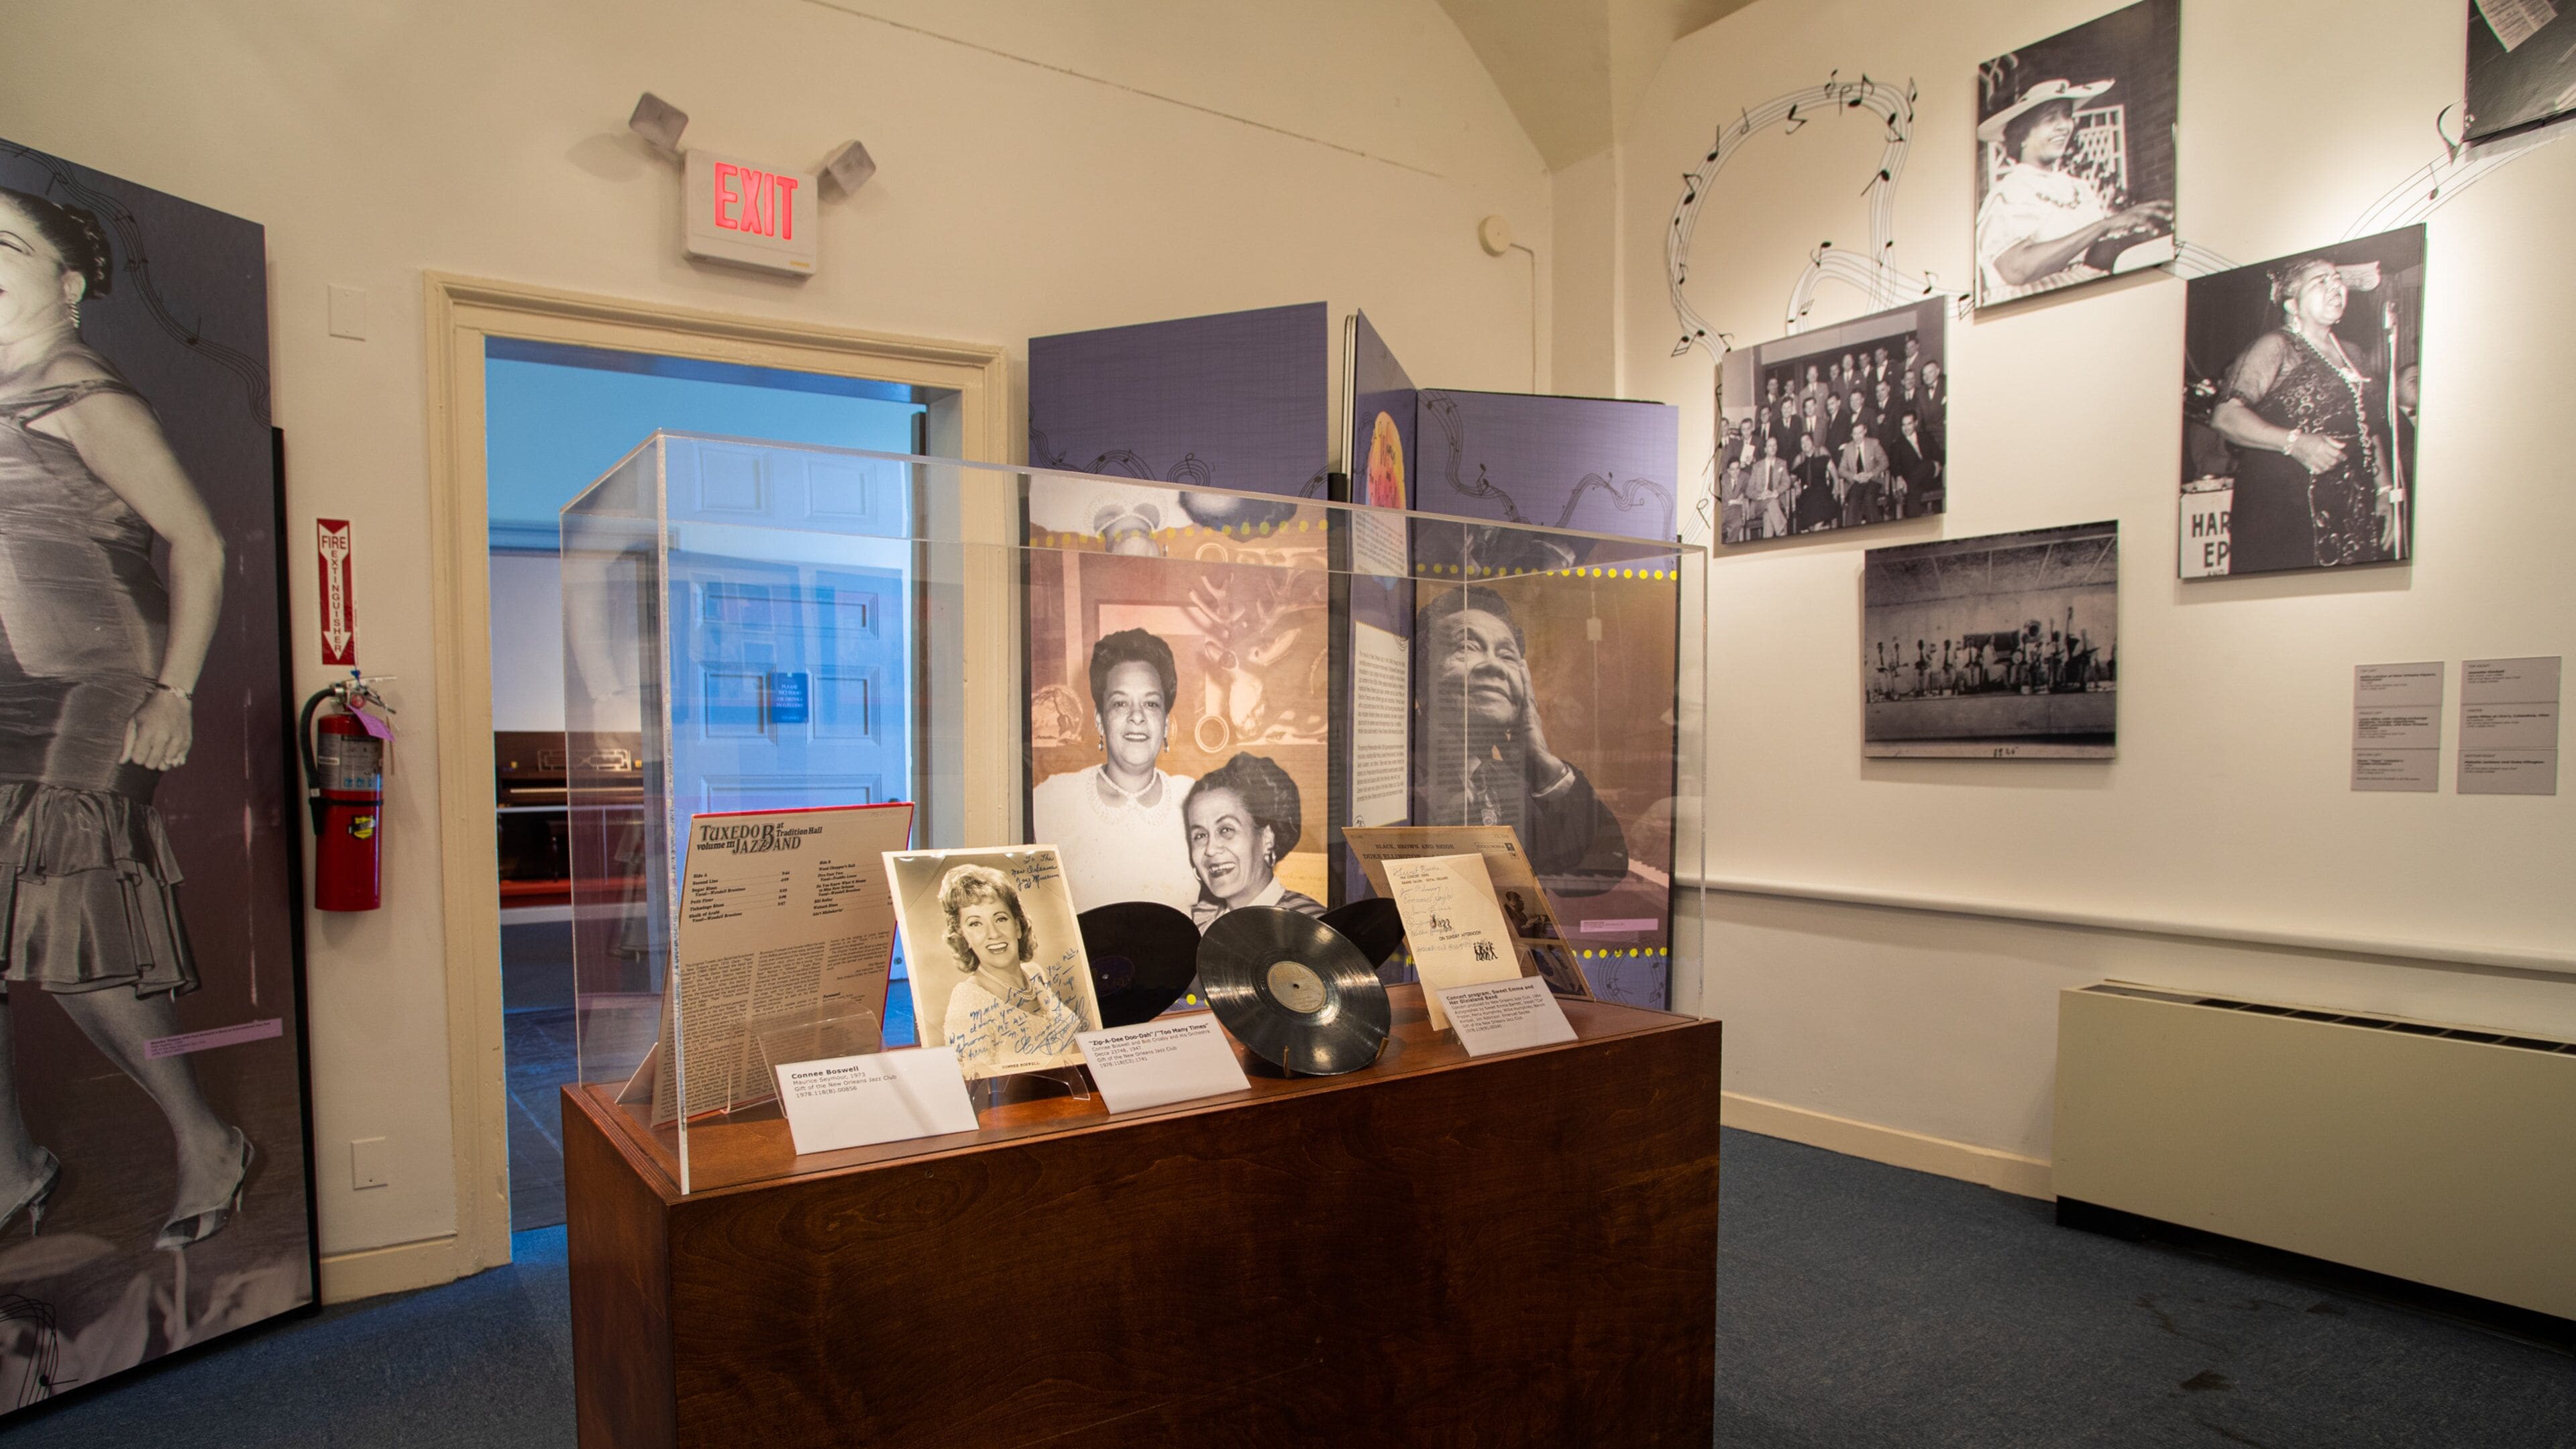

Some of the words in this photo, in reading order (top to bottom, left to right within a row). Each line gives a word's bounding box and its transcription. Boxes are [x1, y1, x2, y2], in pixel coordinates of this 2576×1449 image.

[714, 162, 798, 240] EXIT
[2192, 511, 2231, 537] HAR
[321, 535, 347, 549] FIRE
[331, 550, 341, 652] EXTINGUISHER
[701, 824, 759, 841] TUXEDO
[776, 828, 808, 837] Tradition
[808, 826, 822, 835] Hall
[696, 841, 725, 851] volume
[1172, 1026, 1189, 1035] Many
[1135, 1049, 1153, 1057] Orleans
[792, 1071, 823, 1079] Connee
[826, 1066, 859, 1075] Boswell
[819, 1075, 849, 1083] Seymour,
